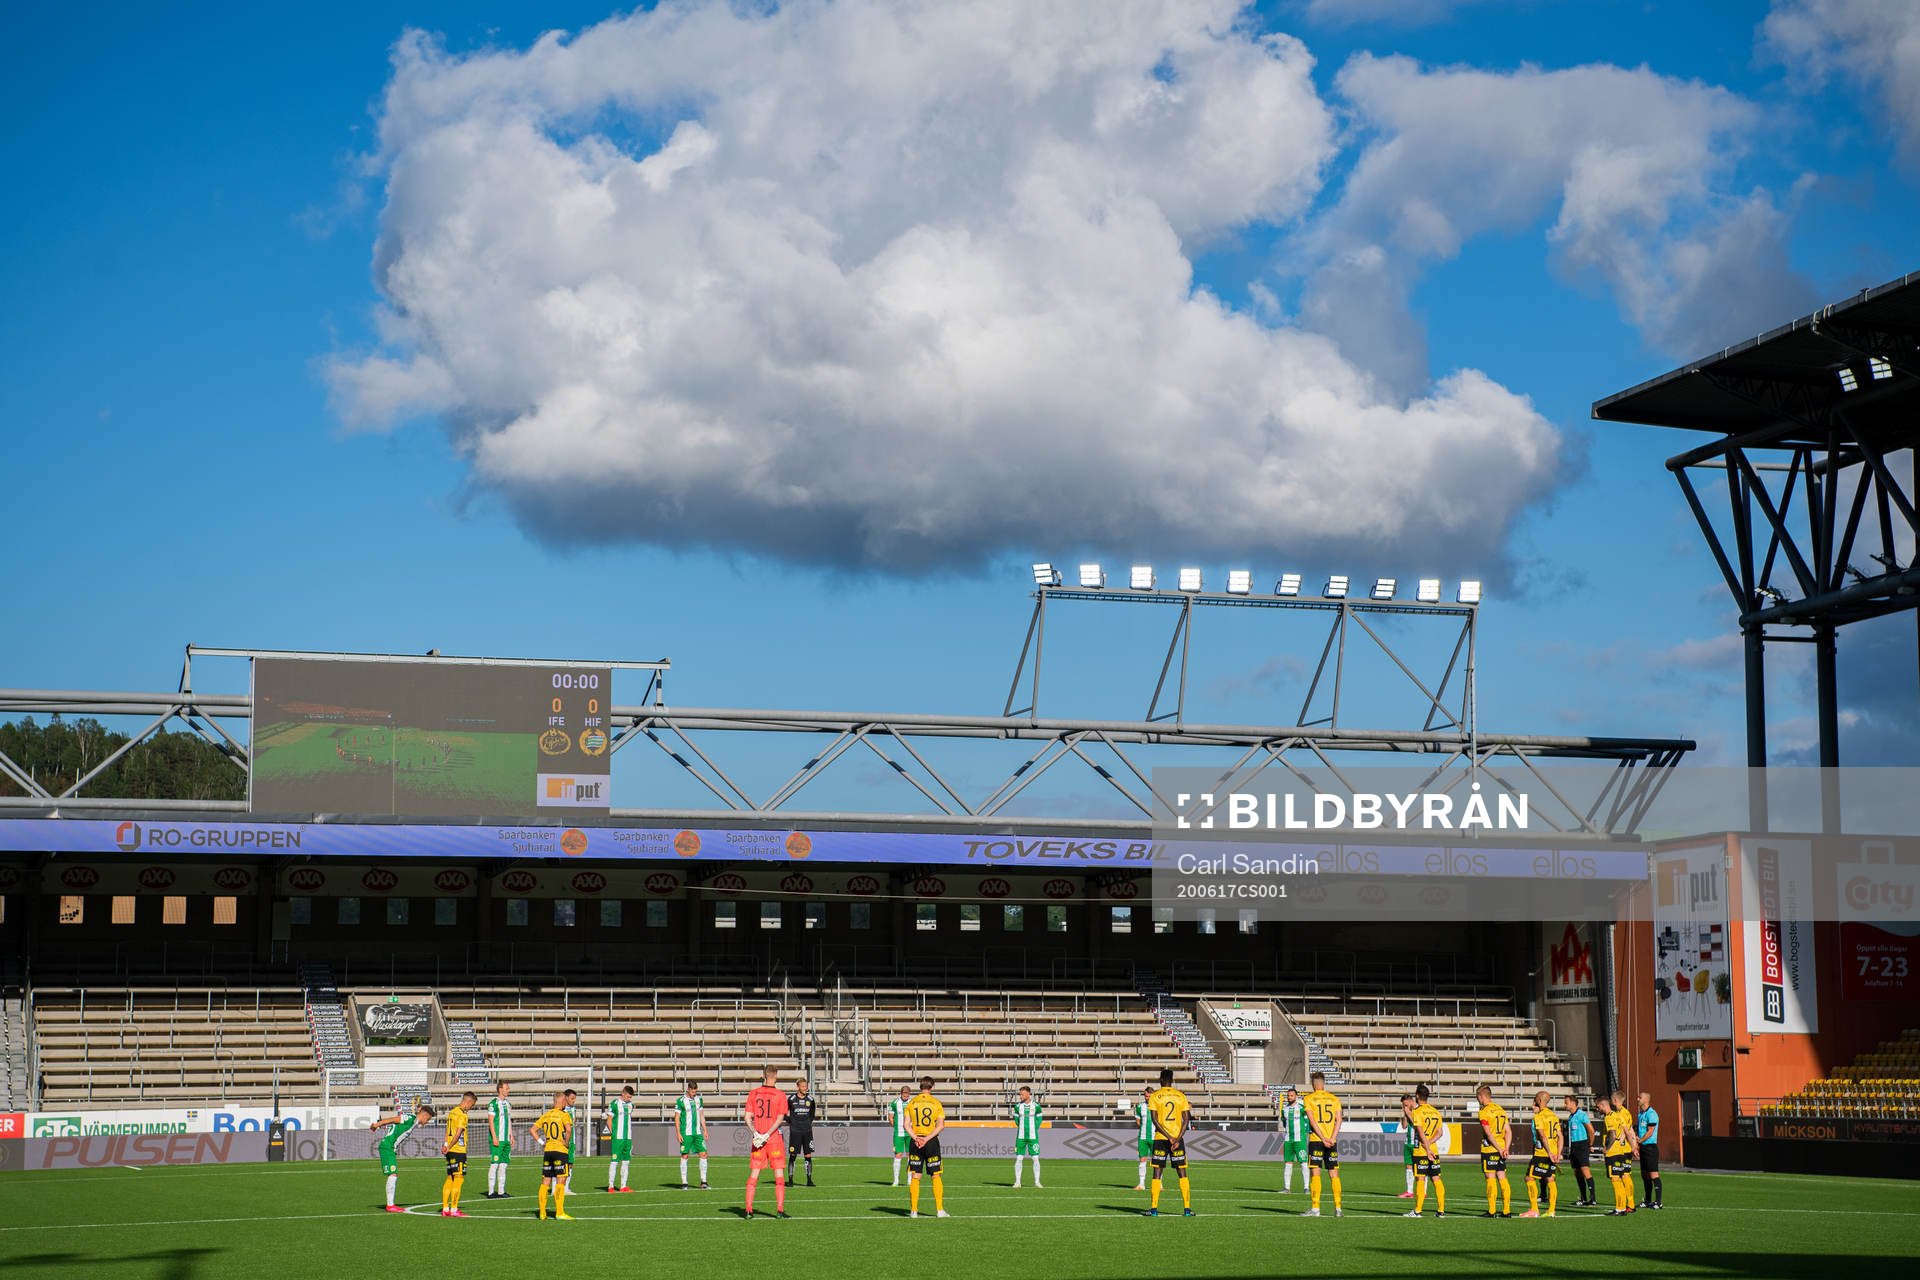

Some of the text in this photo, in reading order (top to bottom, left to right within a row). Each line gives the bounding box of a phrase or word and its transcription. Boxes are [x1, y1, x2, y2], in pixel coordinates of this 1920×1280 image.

[552, 673, 599, 689] 00:00
[552, 697, 599, 714] 0 0
[548, 716, 566, 726] IFE
[149, 829, 301, 848] RO-GRUPPEN
[498, 829, 556, 841] Sparbanken
[613, 832, 670, 842] Sparbanken
[726, 833, 781, 844] Sparbanken
[963, 841, 1172, 861] TOVEKS BIL
[65, 870, 95, 883] AXA
[141, 870, 173, 884] AXA
[217, 871, 248, 885] AXA
[292, 872, 322, 885] AXA
[365, 872, 395, 885] AXA
[437, 872, 466, 886] AXA
[505, 874, 534, 888] AXA
[575, 875, 604, 888] AXA
[647, 875, 676, 889] AXA
[715, 876, 744, 890] AXA
[783, 877, 811, 891] AXA
[850, 879, 877, 892] AXA
[915, 880, 944, 893] AXA
[981, 881, 1009, 894] AXA
[1046, 882, 1073, 895] AXA
[1109, 883, 1136, 896] AXA
[1764, 887, 1779, 979] BOGSTEDT
[756, 1098, 771, 1118] 31
[1165, 1101, 1176, 1121] 2
[1316, 1104, 1334, 1124] 15
[913, 1107, 932, 1127] 18
[542, 1121, 559, 1140] 20
[1424, 1116, 1439, 1137] 27
[1496, 1115, 1506, 1135] 17
[1548, 1120, 1559, 1140] 16
[42, 1132, 235, 1168] PULSEN
